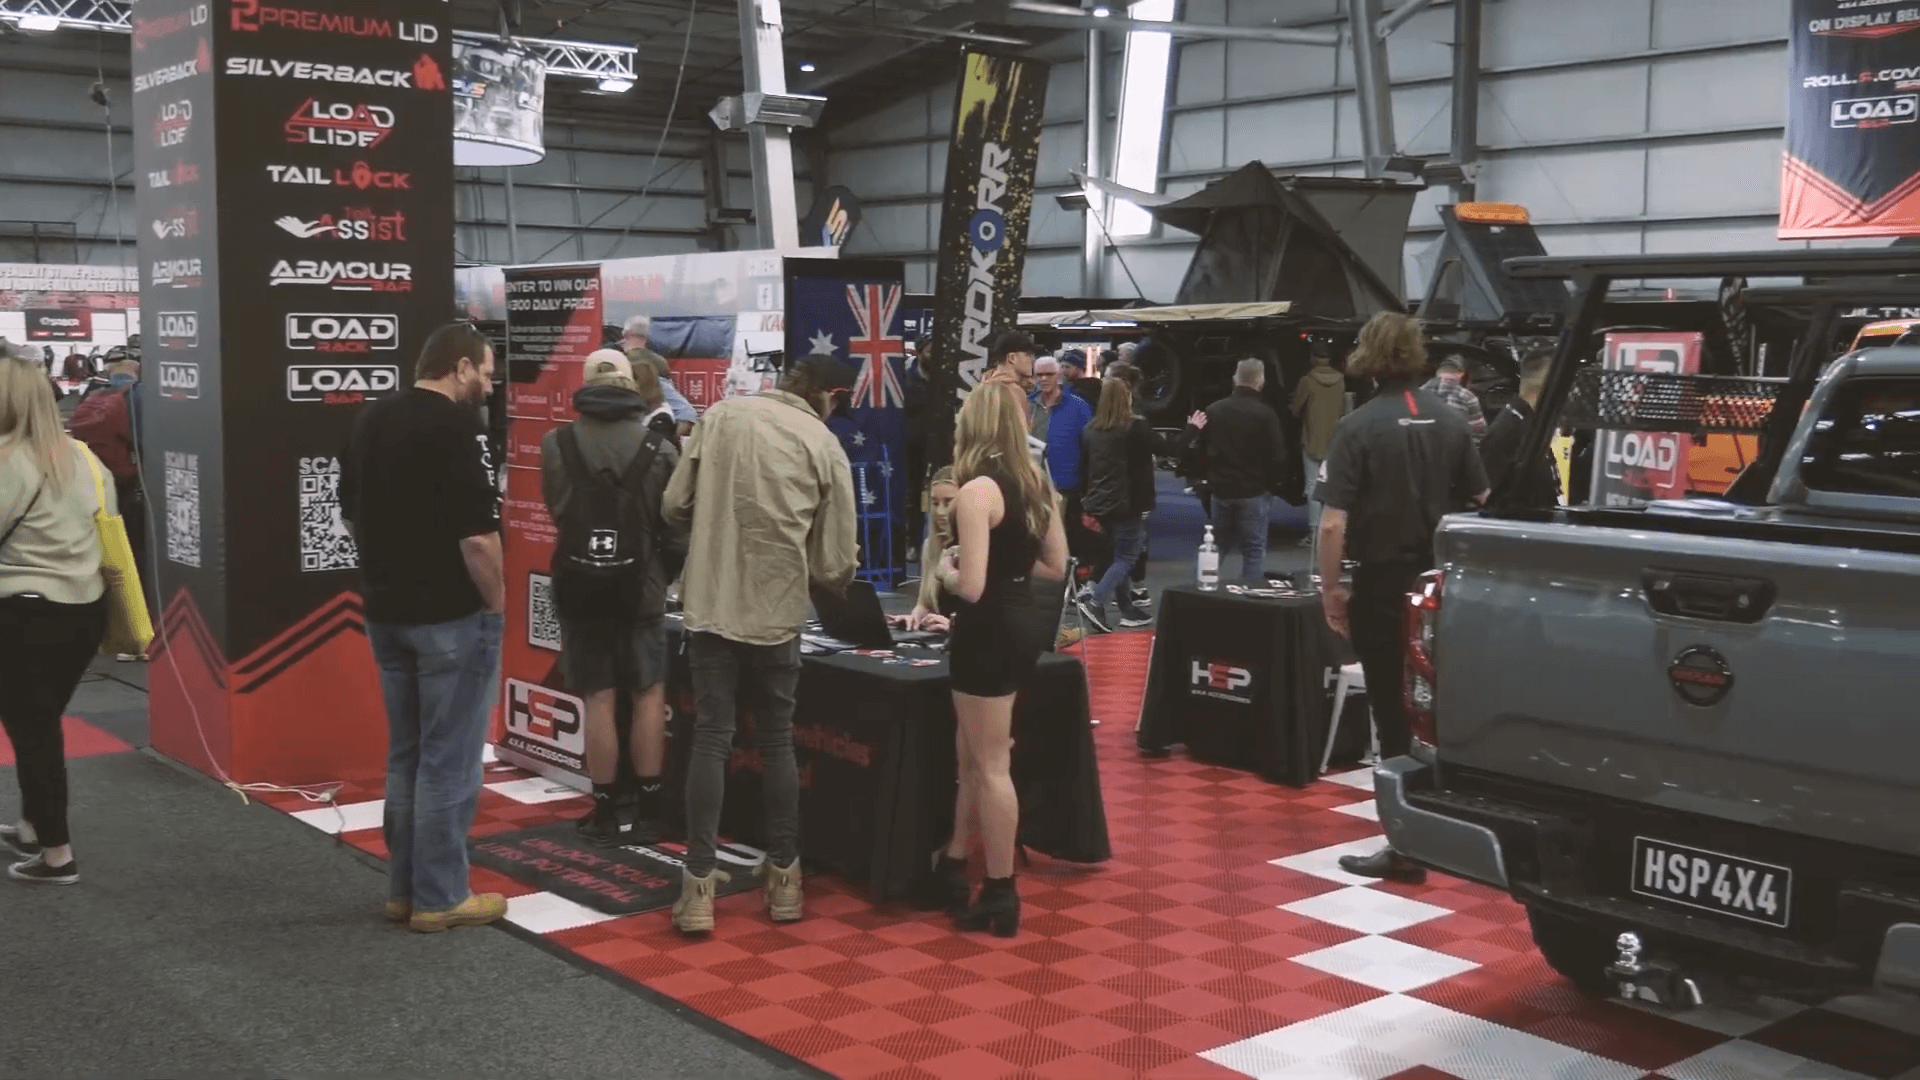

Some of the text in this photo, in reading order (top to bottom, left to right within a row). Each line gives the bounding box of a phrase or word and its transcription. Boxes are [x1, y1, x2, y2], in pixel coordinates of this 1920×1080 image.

[259, 7, 392, 38] PREMIUM
[399, 21, 439, 43] LID
[1808, 19, 1831, 33] ON
[1834, 11, 1892, 29] DISPLAY
[226, 57, 412, 88] SILVERBACK
[312, 101, 396, 128] LOAD
[1833, 98, 1915, 121] LOAD
[285, 121, 381, 147] SLIDE
[266, 165, 331, 184] TAIL
[270, 260, 412, 281] ARMOUR
[957, 141, 1011, 400] ARDKORR
[505, 281, 536, 293] ENTER
[538, 280, 552, 292] TO
[553, 279, 572, 292] WIN
[574, 278, 599, 291] OUR
[533, 298, 562, 311] DAILY
[562, 297, 595, 310] PRIZE
[158, 316, 197, 337] LOAD
[290, 318, 395, 340] LOAD
[160, 366, 198, 389] LOAD
[291, 370, 396, 392] LOAD
[1607, 430, 1676, 471] LOAD
[299, 457, 341, 475] SCA
[1191, 660, 1252, 690] HSP
[1643, 847, 1778, 916] HSP4X4
